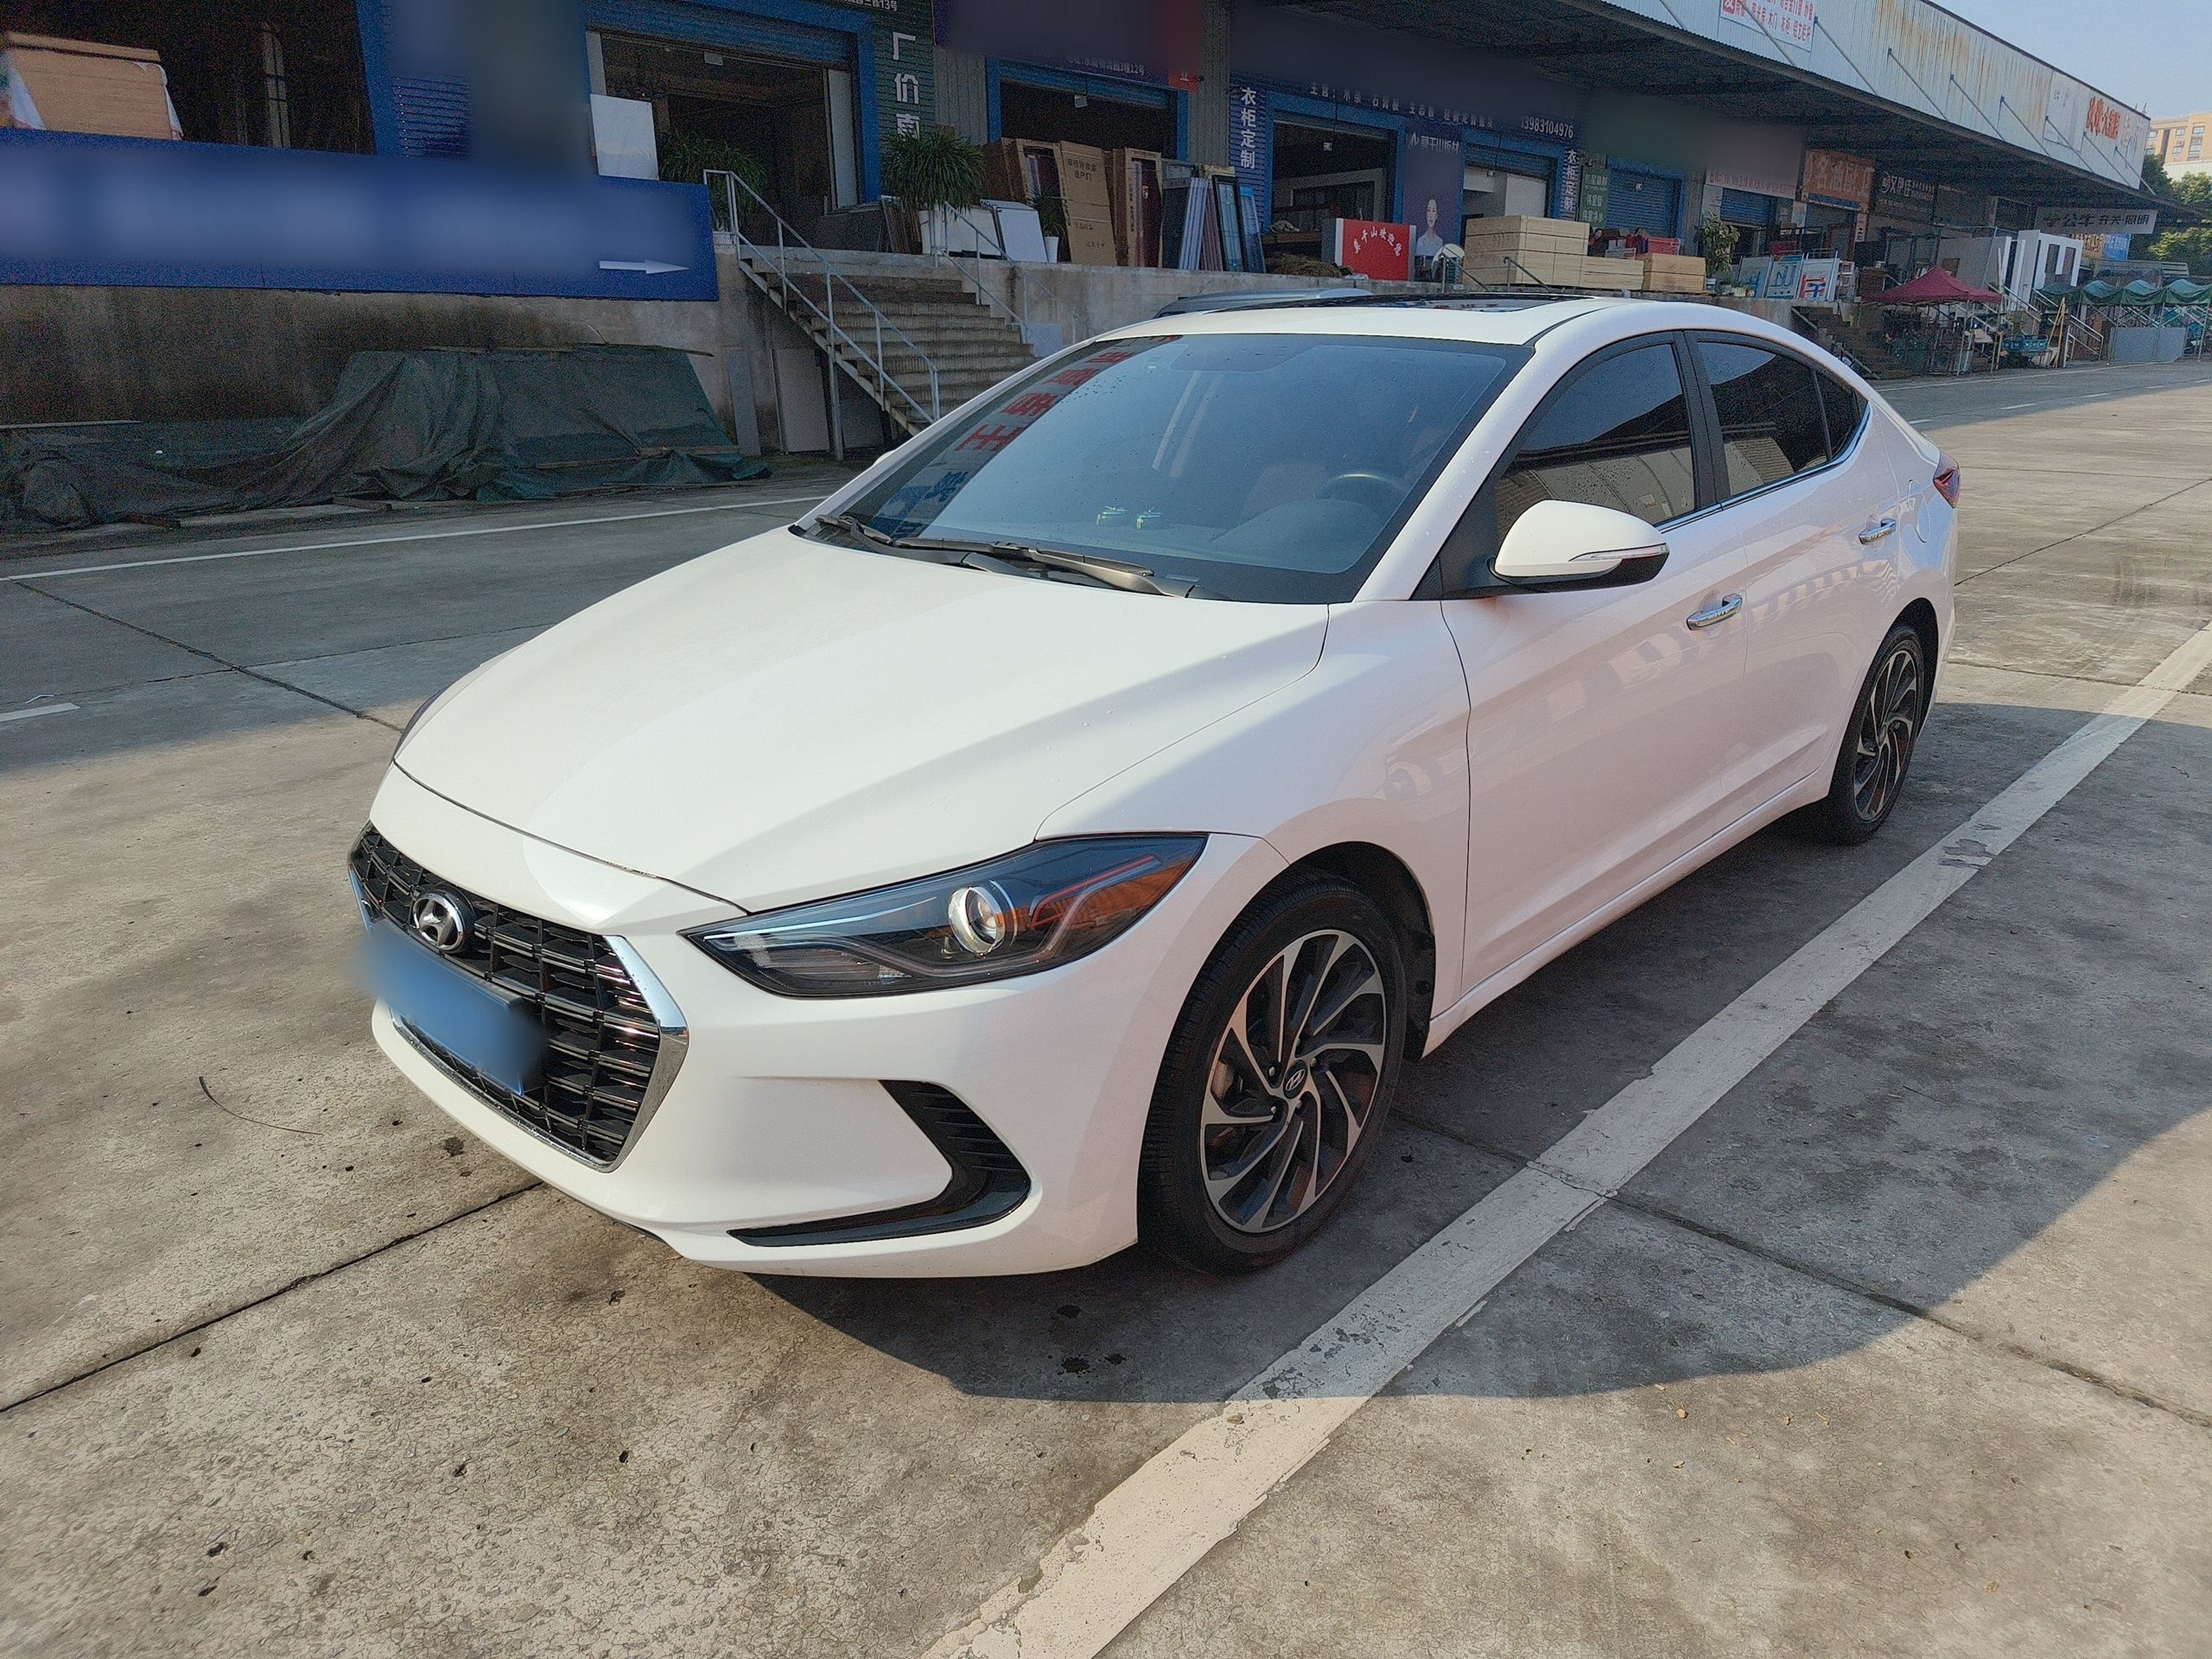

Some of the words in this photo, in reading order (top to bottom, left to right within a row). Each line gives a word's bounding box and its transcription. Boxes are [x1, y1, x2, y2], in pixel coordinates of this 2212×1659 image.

[1240, 86, 1257, 169] 衣柜定制
[1563, 149, 1578, 211] 衣柜定制
